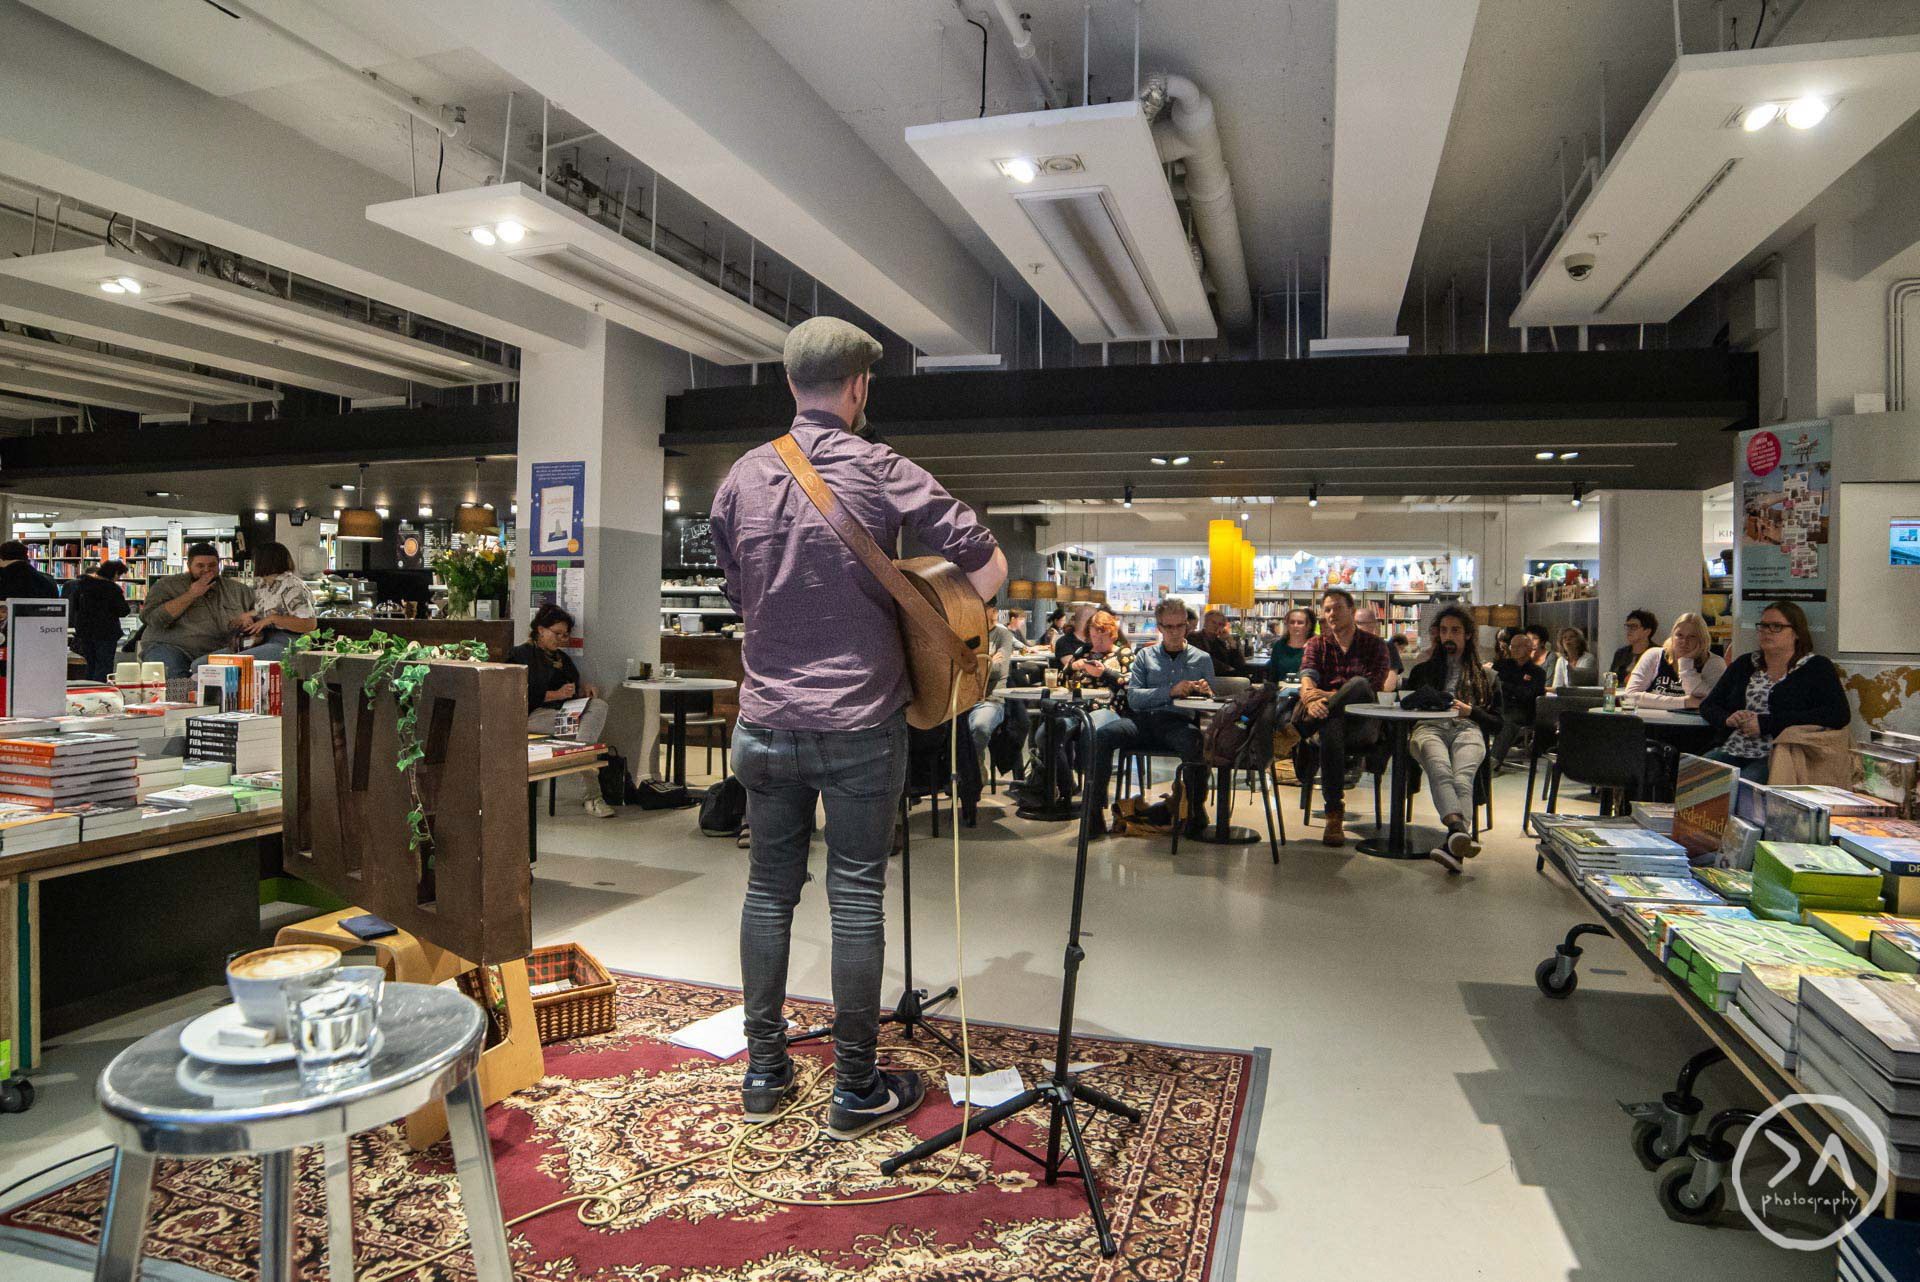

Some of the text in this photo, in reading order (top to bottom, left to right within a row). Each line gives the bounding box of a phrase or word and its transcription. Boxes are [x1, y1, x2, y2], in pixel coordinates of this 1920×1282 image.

[39, 625, 63, 633] Sport
[189, 719, 202, 727] FIFA
[189, 729, 202, 737] FIFA
[189, 738, 202, 746] FIFA
[189, 747, 202, 755] FIFA
